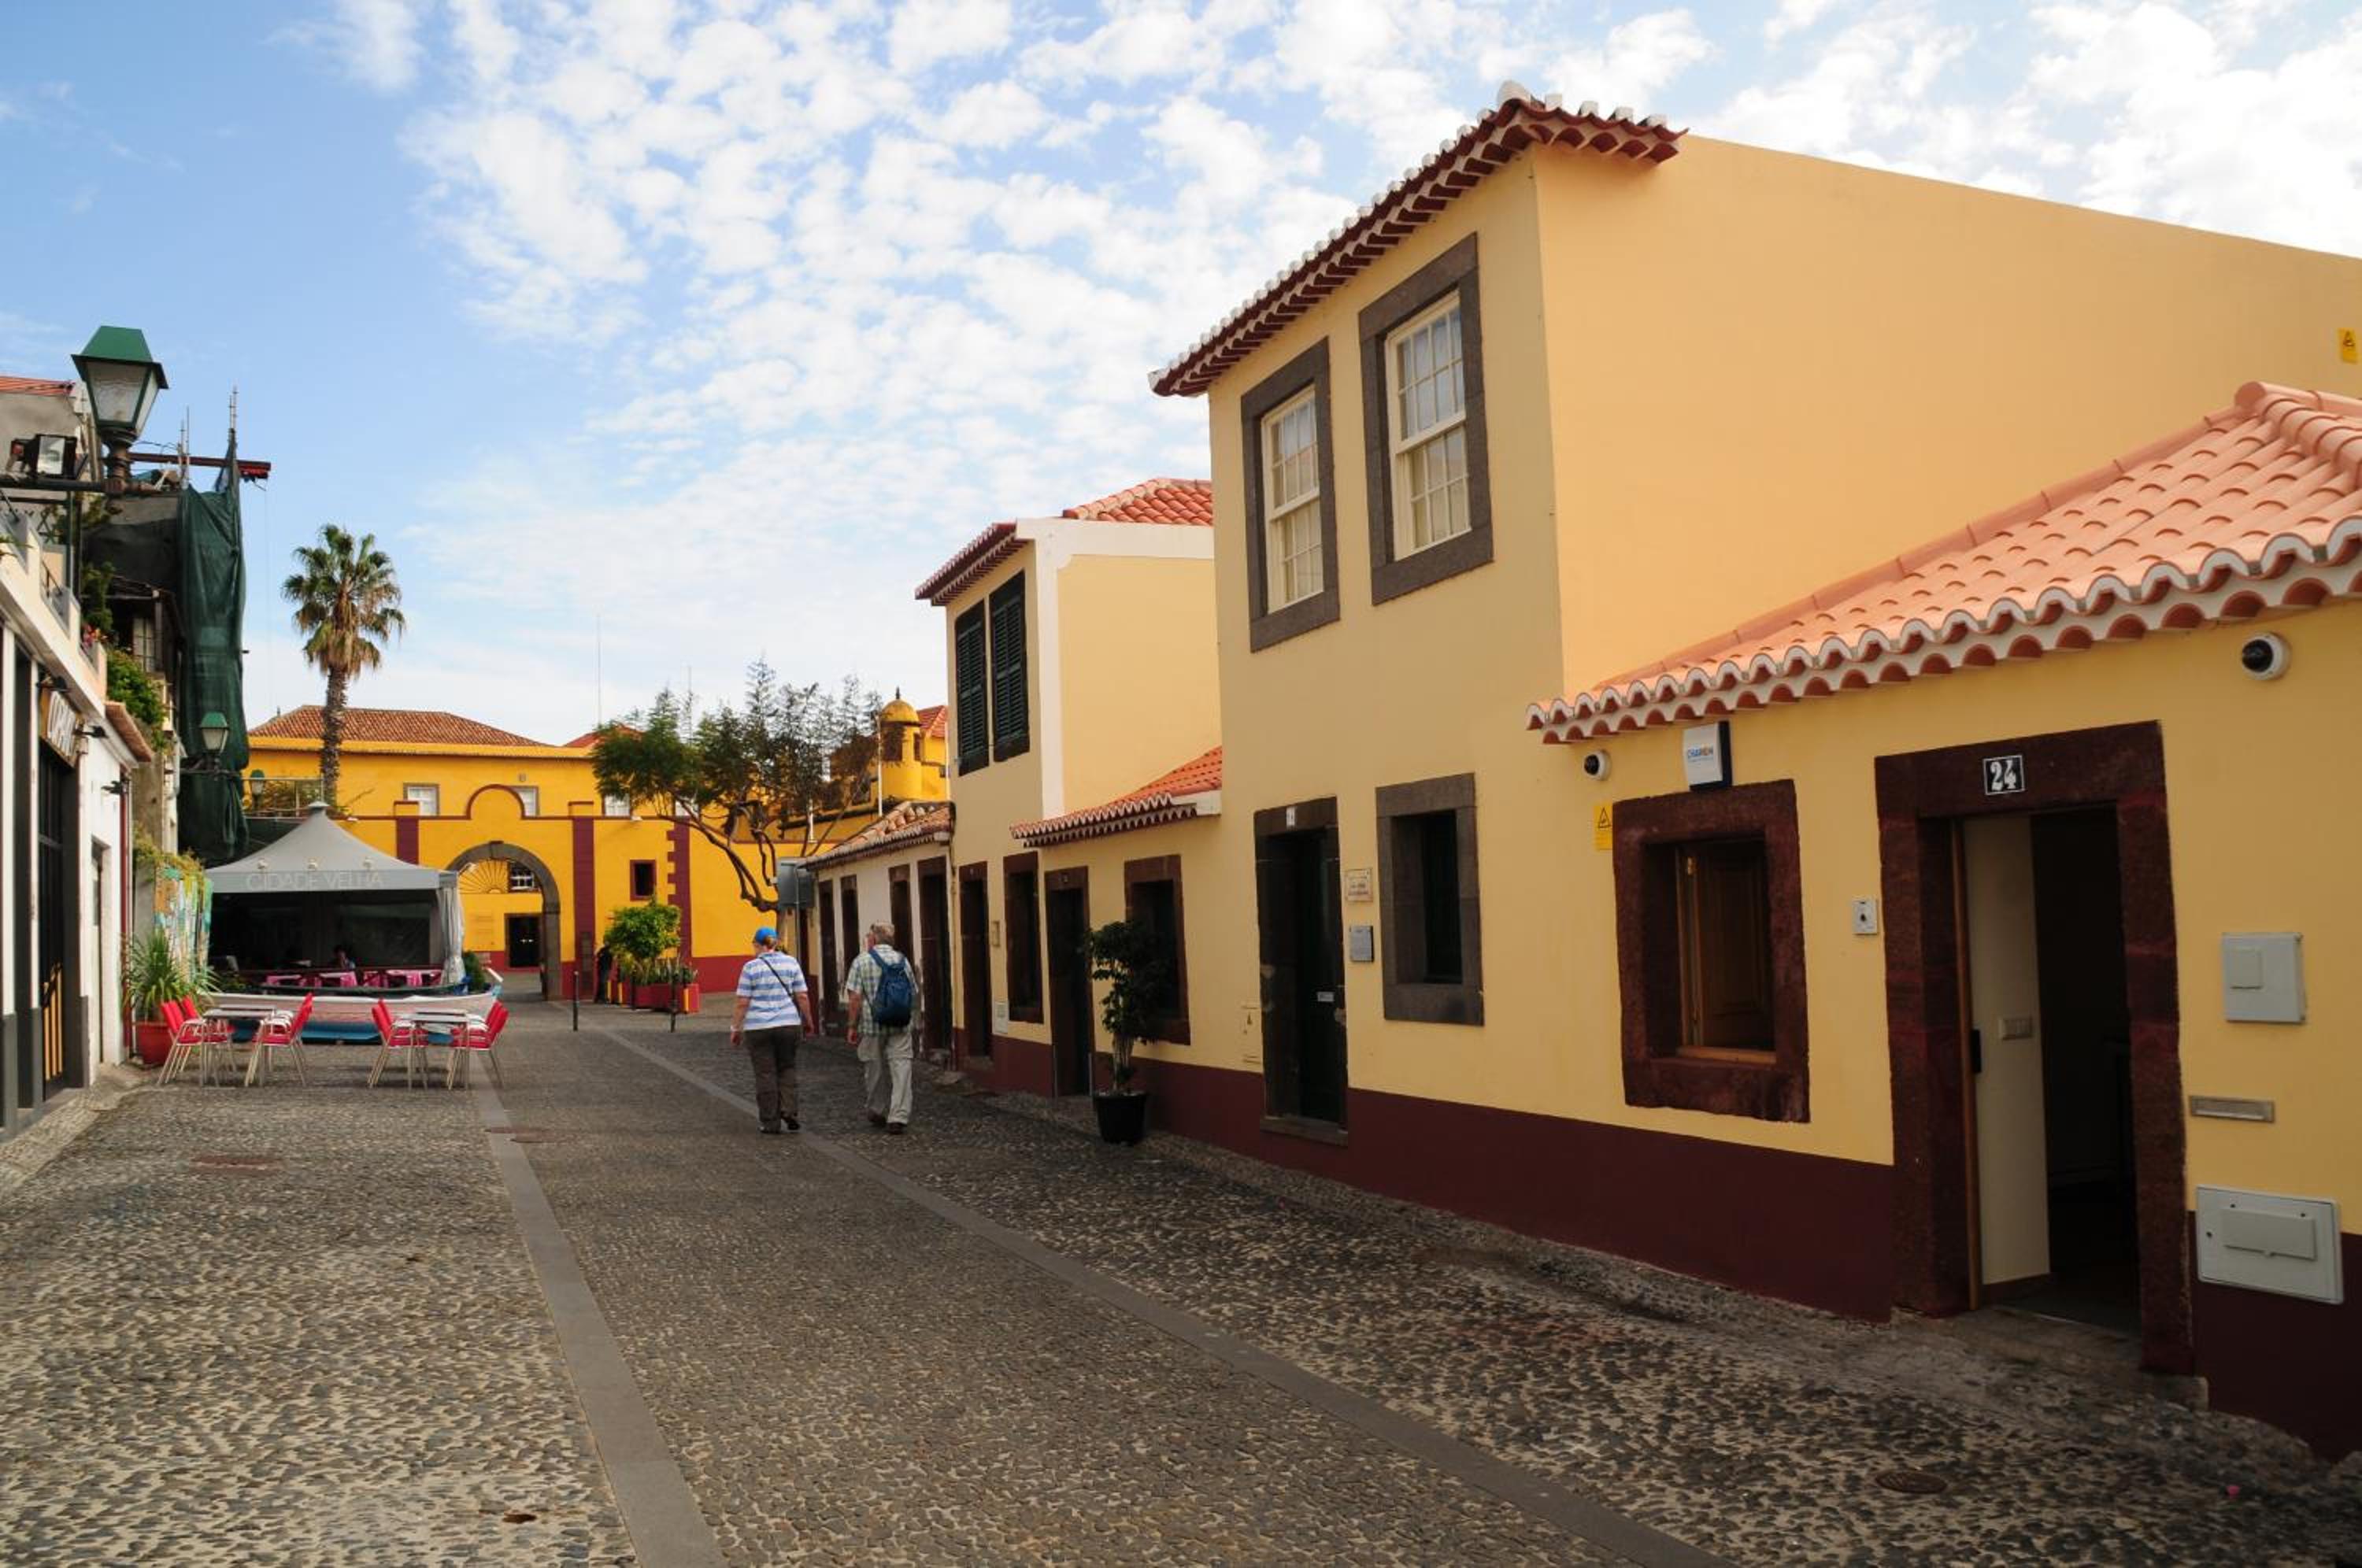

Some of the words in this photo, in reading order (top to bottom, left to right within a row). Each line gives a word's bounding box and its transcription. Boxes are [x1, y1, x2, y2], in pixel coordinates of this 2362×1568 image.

[1990, 760, 2016, 790] 24
[246, 872, 319, 890] CIDADE
[324, 871, 383, 889] VELHA
